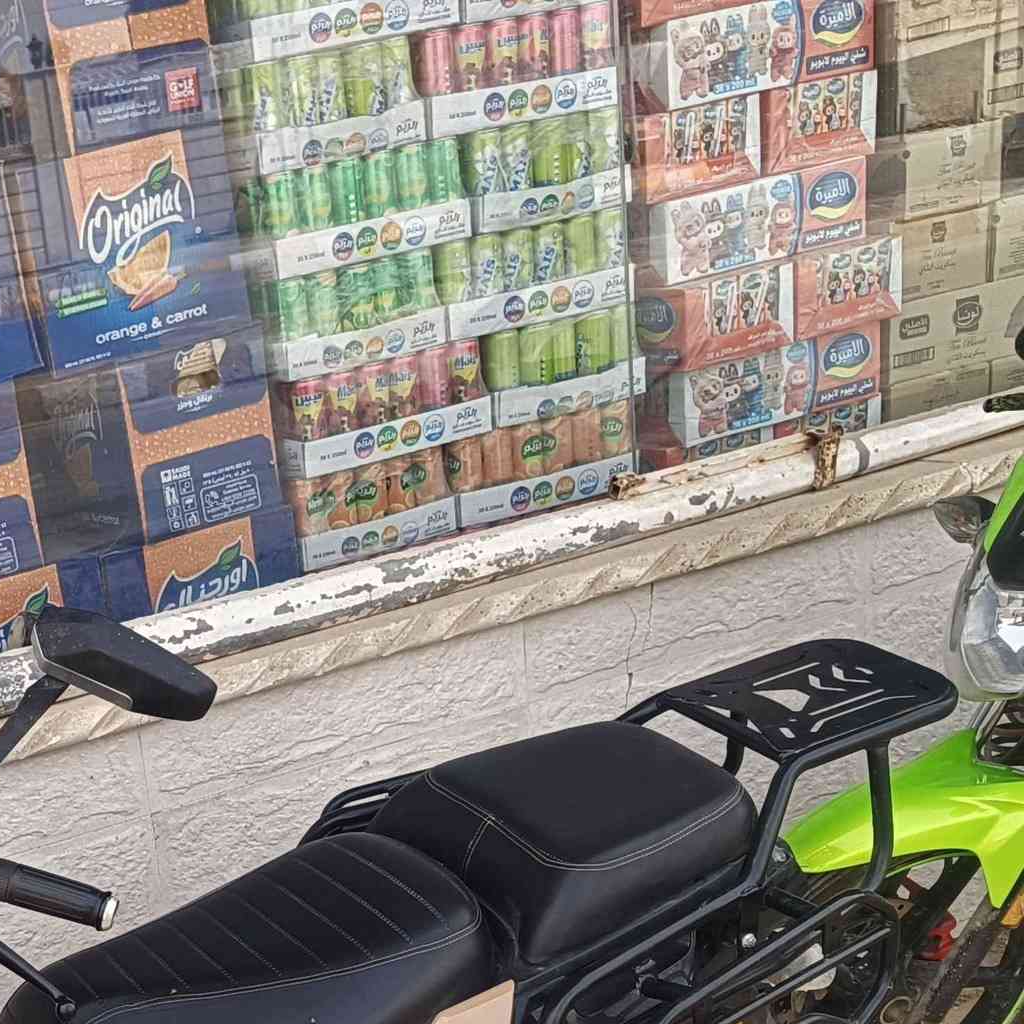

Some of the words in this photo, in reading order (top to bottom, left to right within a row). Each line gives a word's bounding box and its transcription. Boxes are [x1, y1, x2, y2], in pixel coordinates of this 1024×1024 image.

[88, 179, 184, 267] Original
[96, 320, 147, 345] orange
[151, 316, 163, 329] &
[166, 303, 208, 325] carrot
